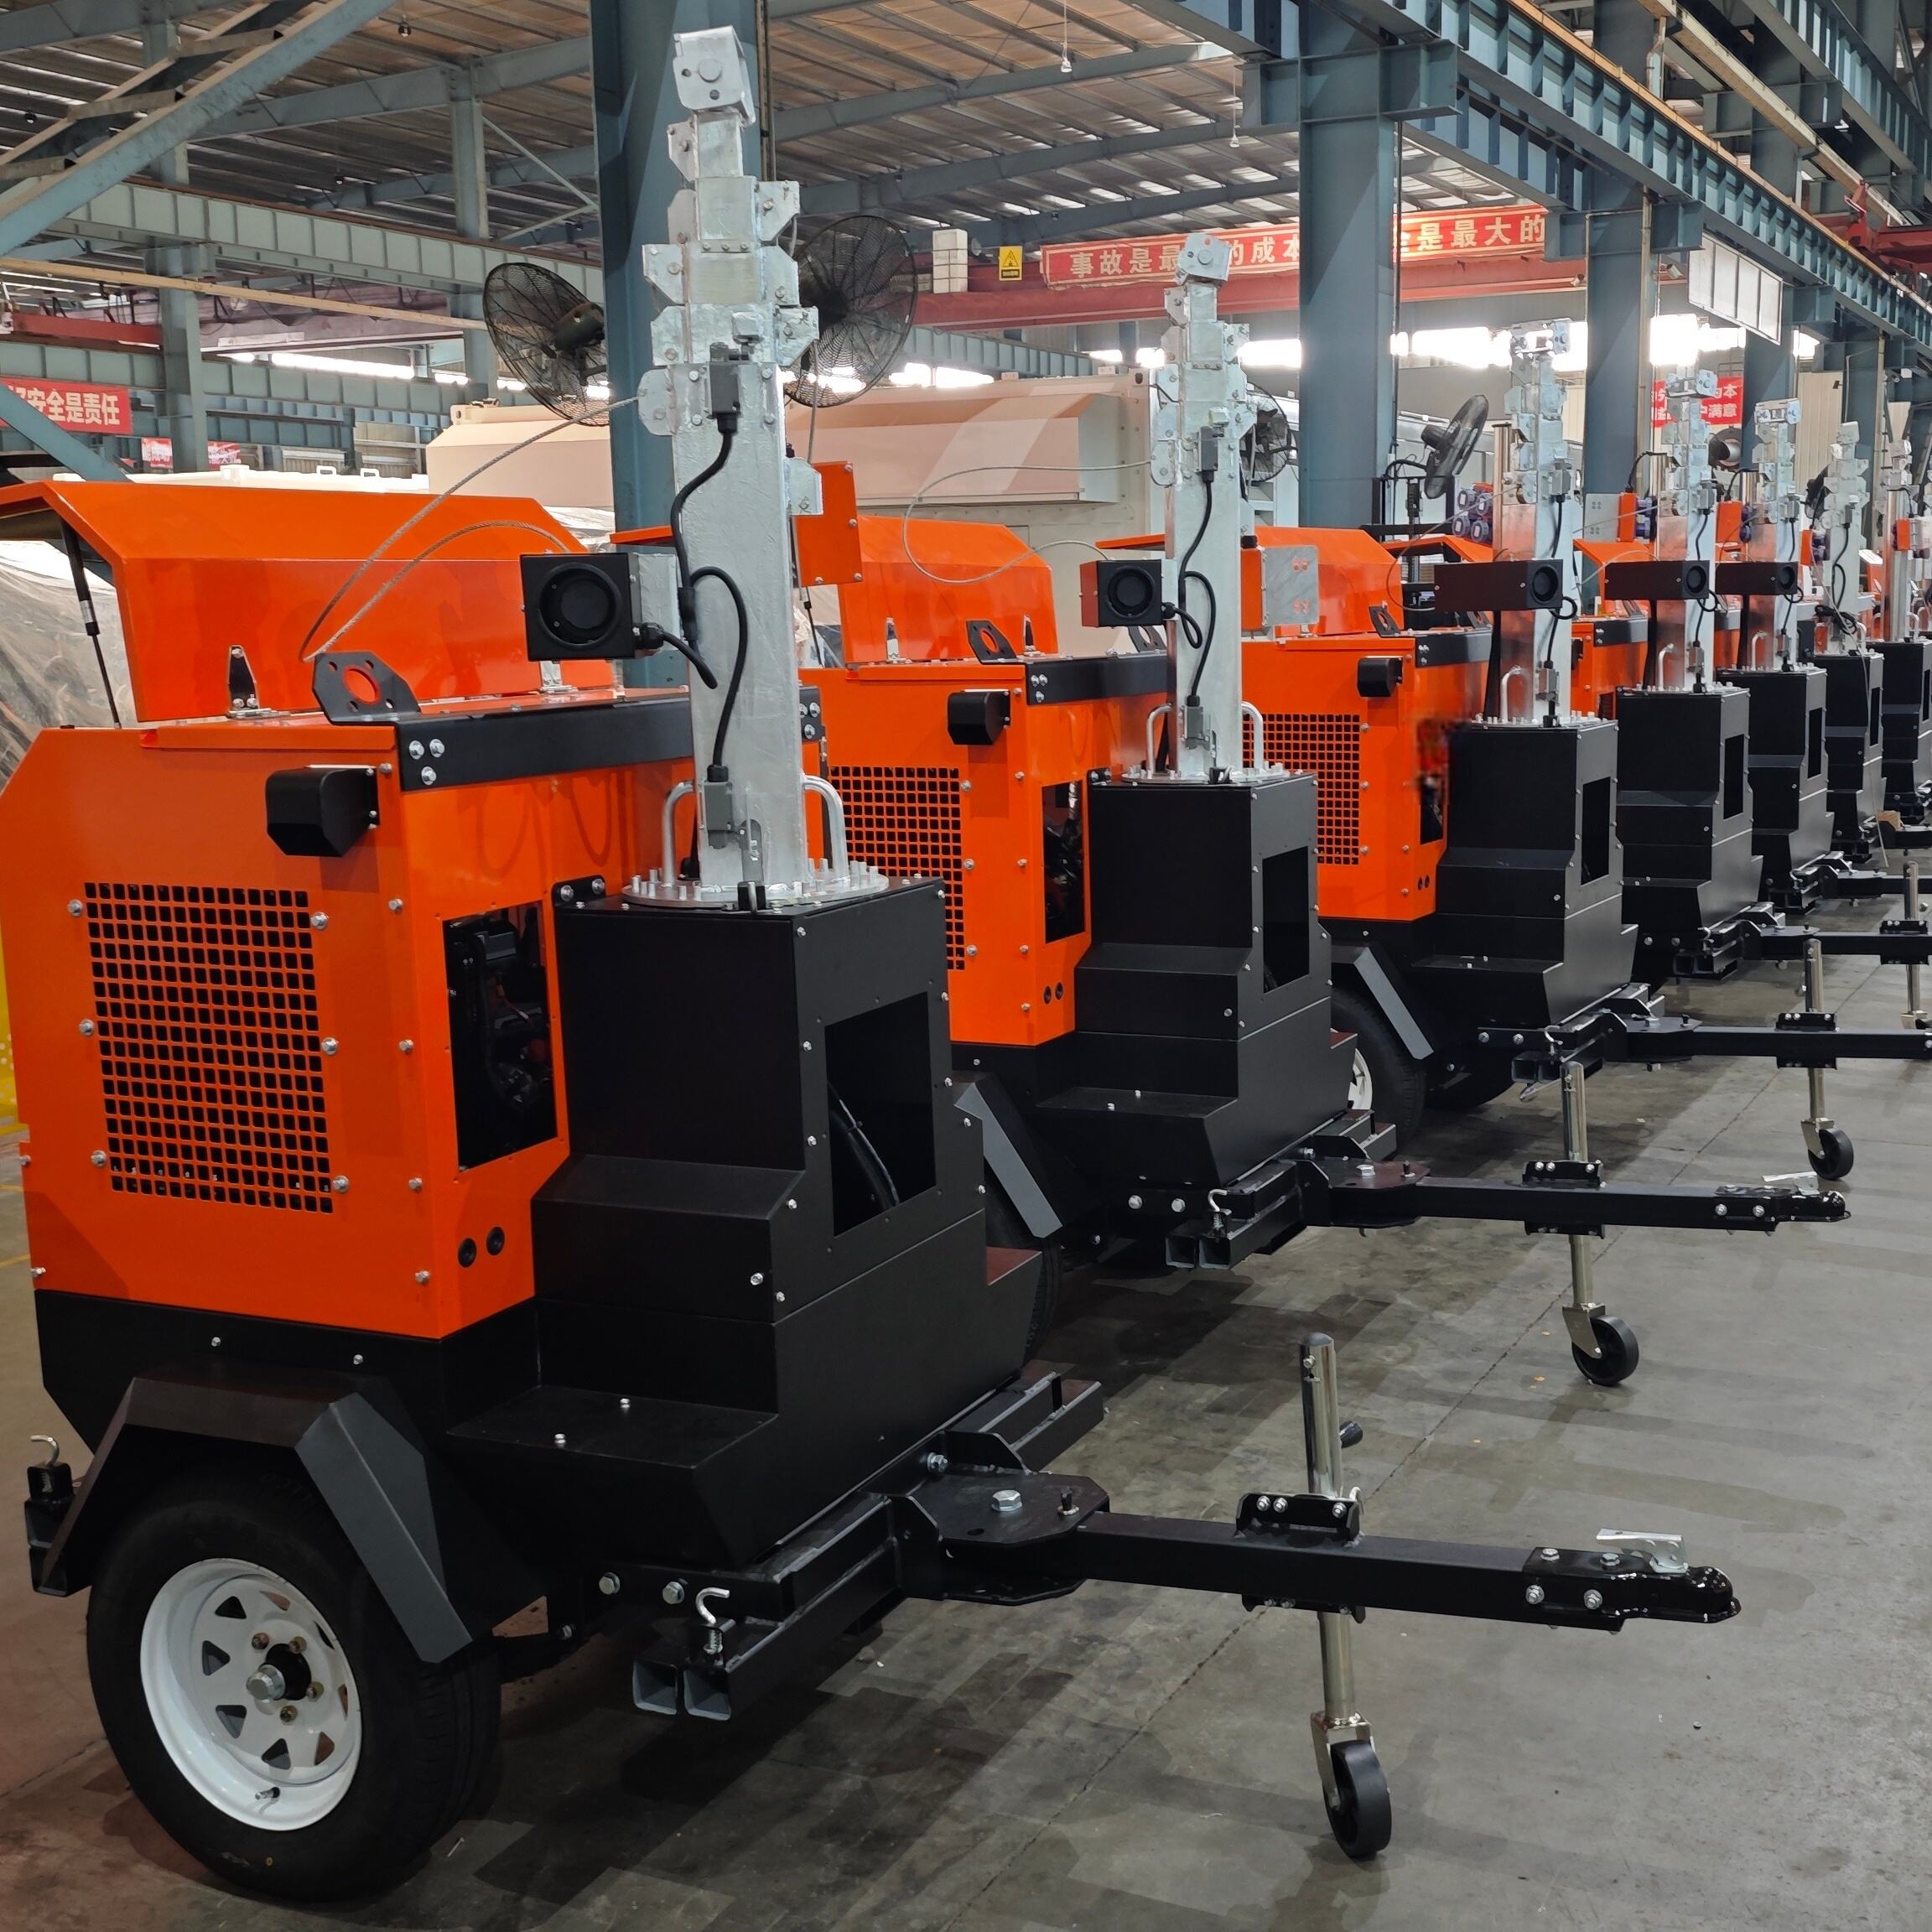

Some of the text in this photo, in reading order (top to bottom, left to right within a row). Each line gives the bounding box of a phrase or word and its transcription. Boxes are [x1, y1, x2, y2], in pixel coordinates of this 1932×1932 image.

[8, 385, 120, 425] 安全是责任
